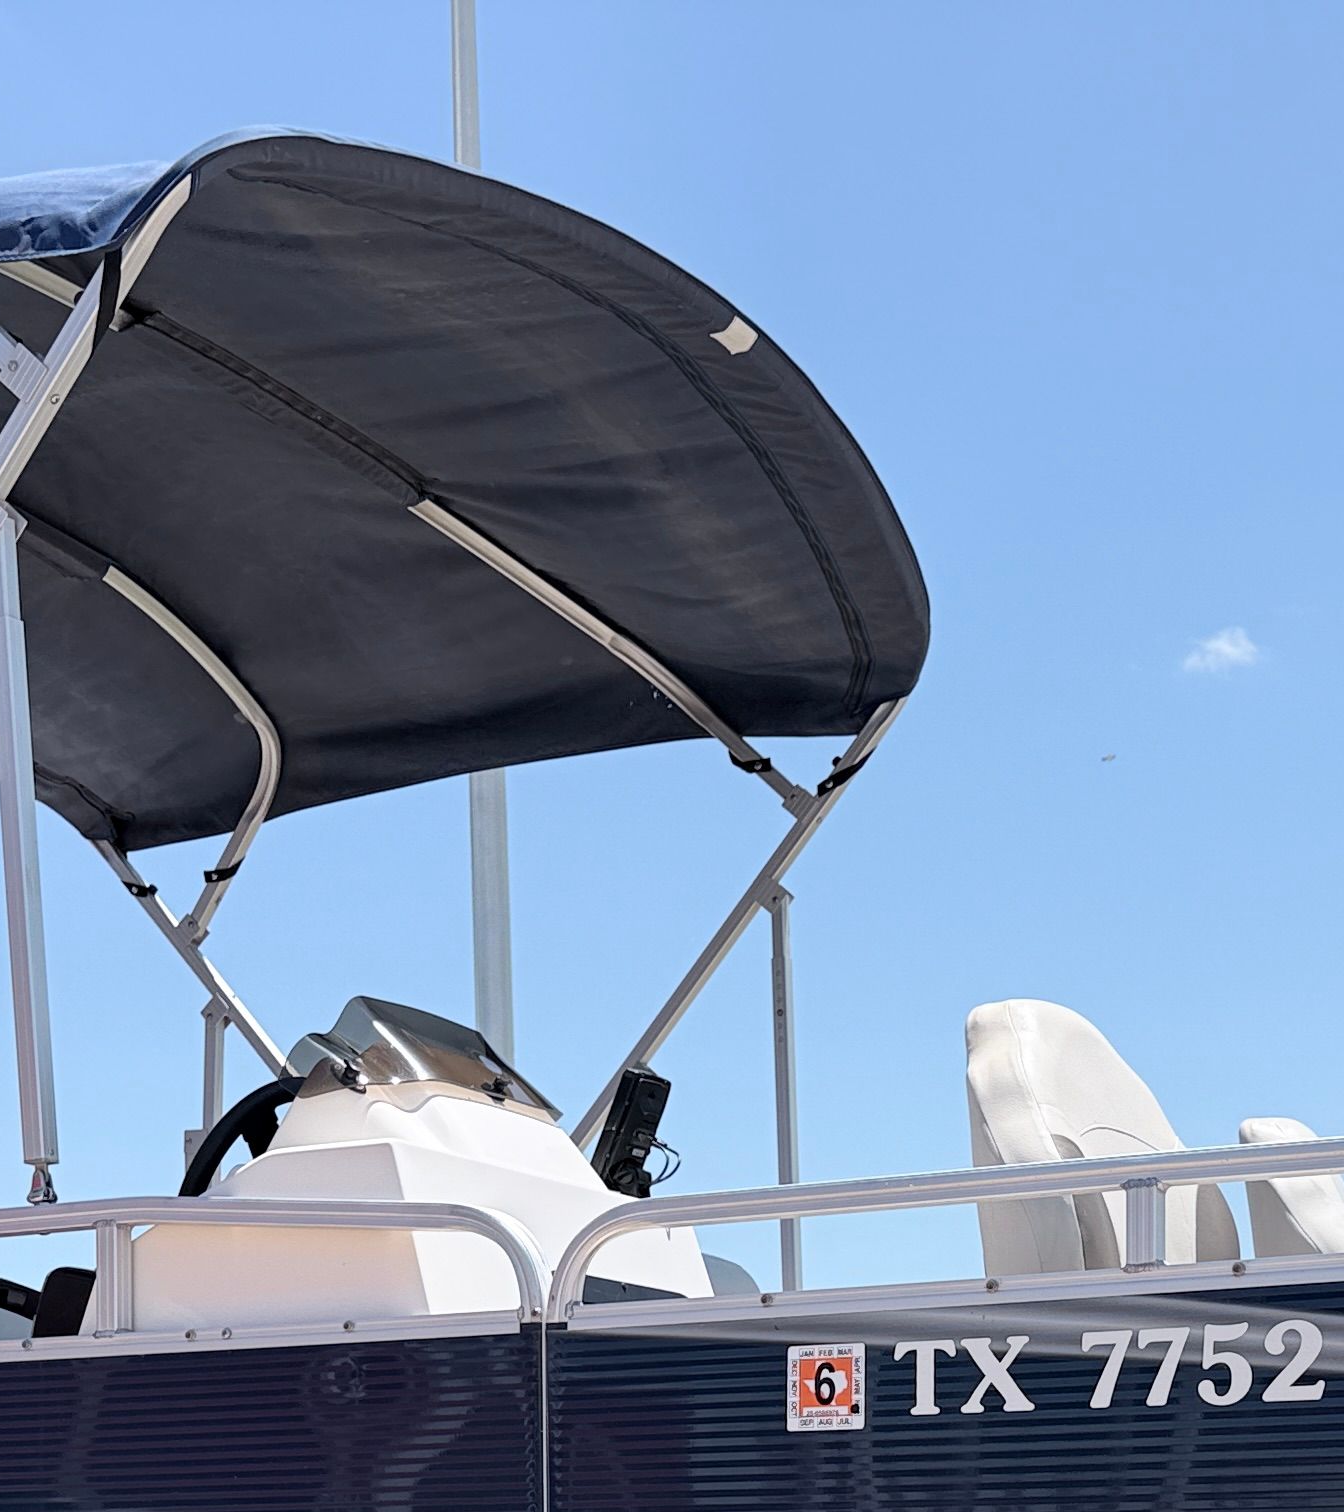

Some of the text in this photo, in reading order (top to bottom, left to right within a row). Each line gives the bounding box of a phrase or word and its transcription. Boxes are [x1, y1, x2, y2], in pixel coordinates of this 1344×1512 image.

[837, 1348, 852, 1356] MAR
[893, 1336, 1036, 1416] TX
[1081, 1319, 1326, 1409] 7752
[814, 1361, 836, 1406] 6
[818, 1418, 833, 1426] AUG
